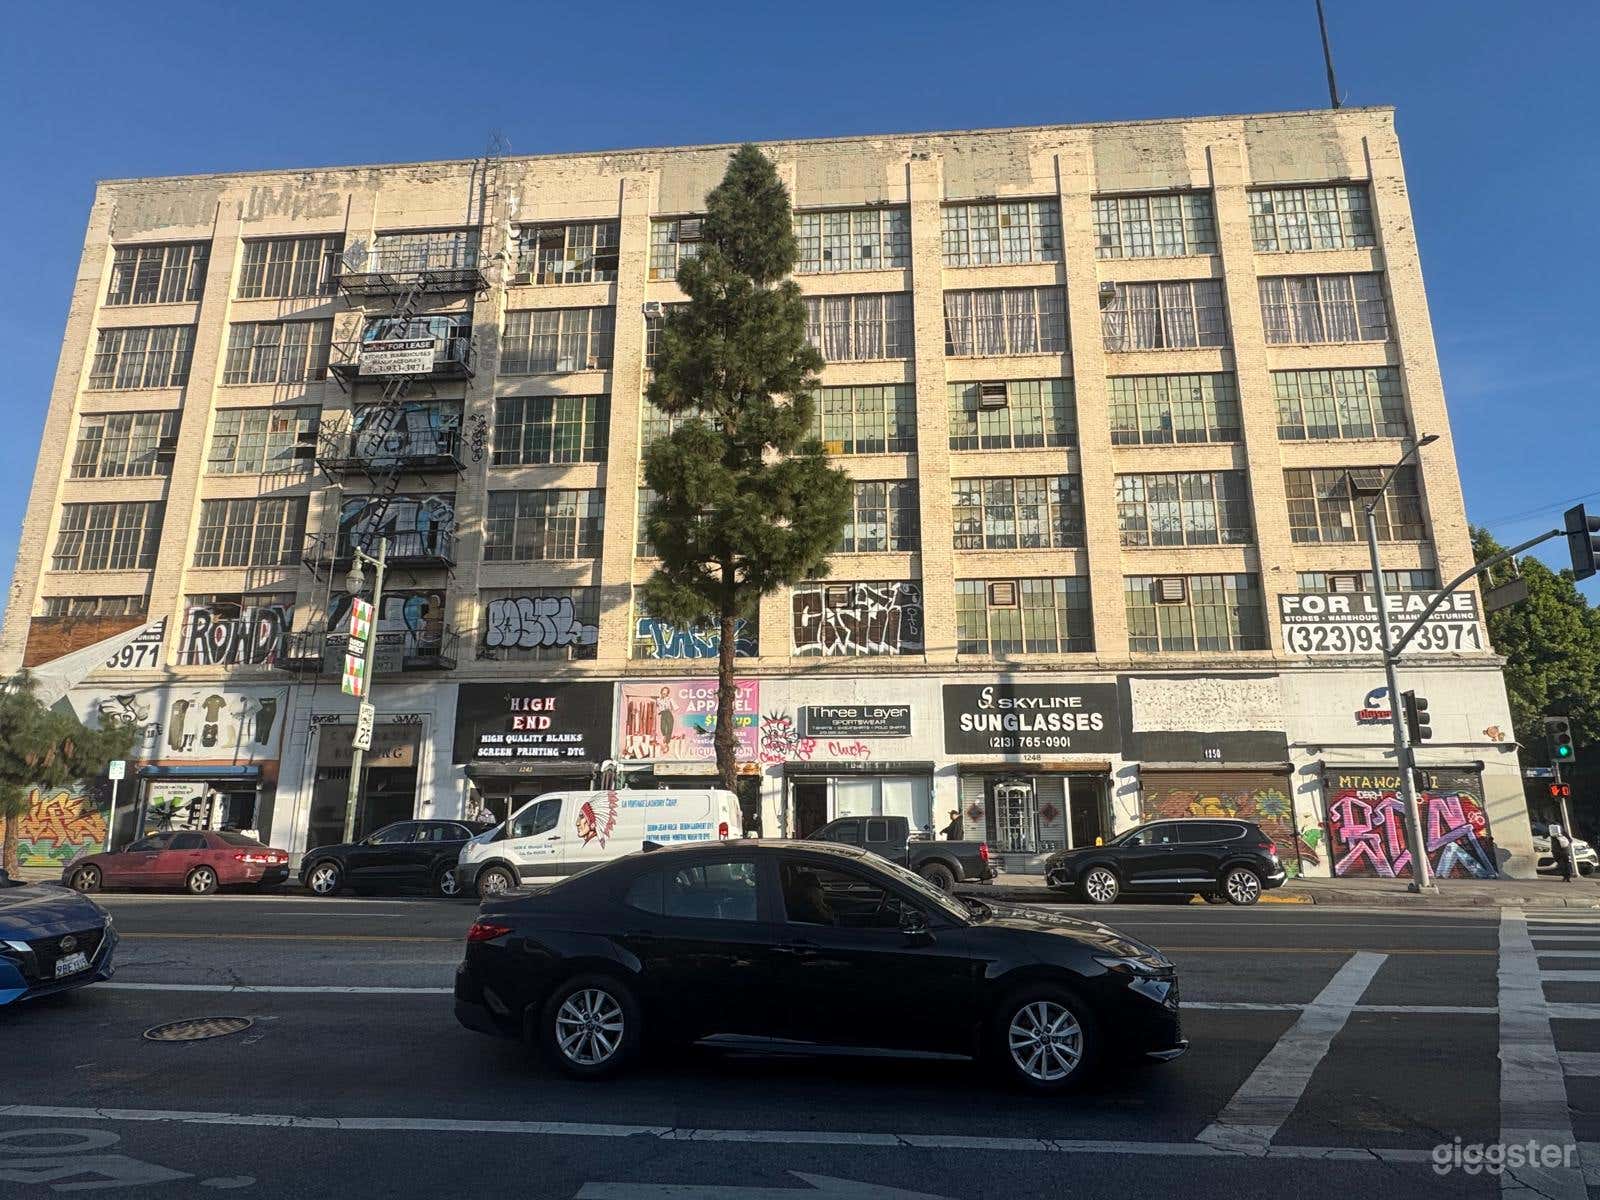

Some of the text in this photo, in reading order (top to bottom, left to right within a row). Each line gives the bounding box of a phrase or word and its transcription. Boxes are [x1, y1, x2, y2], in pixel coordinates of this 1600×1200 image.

[1282, 593, 1474, 614] FOR LEASE
[1398, 612, 1474, 620] MANACTURING
[679, 688, 752, 698] CLOSUT
[510, 698, 556, 711] HIGH
[998, 697, 1082, 708] SKYLINE
[810, 706, 908, 719] Three Layer
[512, 716, 552, 730] END
[960, 712, 1104, 732] SUNGLASSES
[506, 735, 544, 744] QUALITY
[546, 734, 583, 742] BLANKS
[990, 736, 1070, 748] (213) 765-0901
[478, 748, 512, 756] SCREEN
[516, 748, 559, 756] PRINTING
[567, 748, 585, 756] DTG
